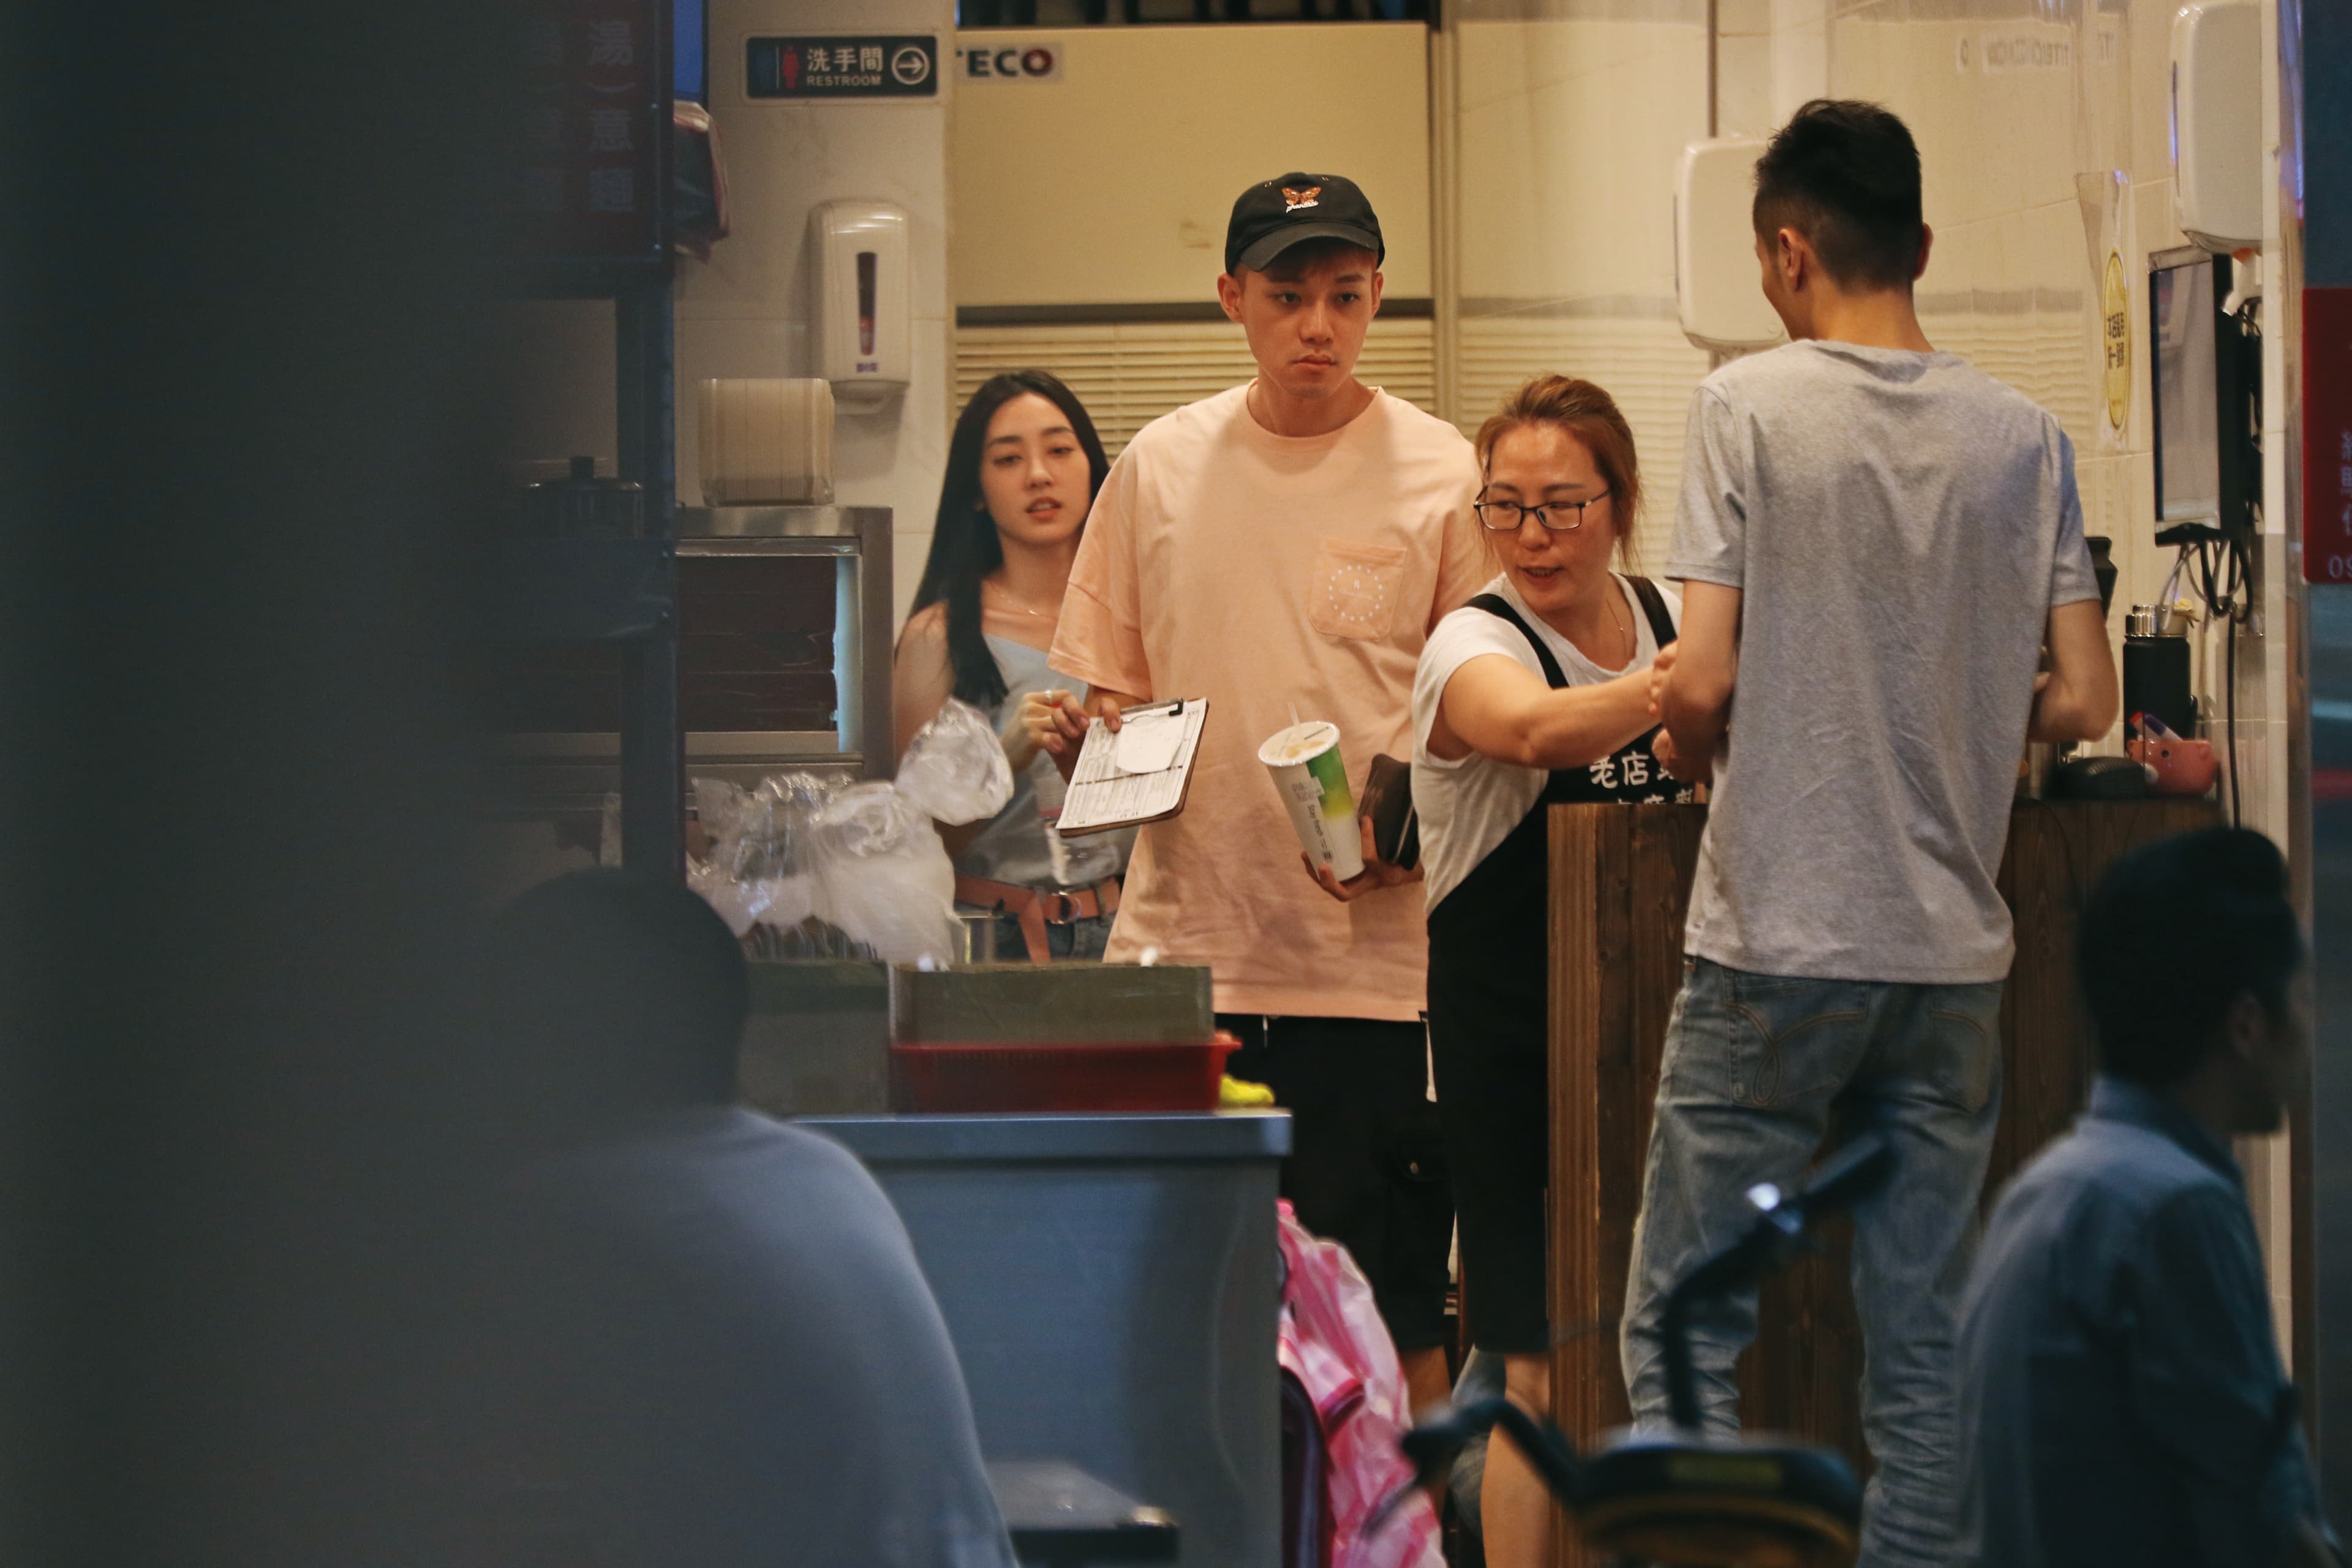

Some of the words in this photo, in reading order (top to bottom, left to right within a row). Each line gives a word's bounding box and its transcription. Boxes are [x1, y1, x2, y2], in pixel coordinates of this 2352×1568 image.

[807, 46, 884, 72] 洗手間
[954, 49, 1054, 77] ECO
[806, 75, 882, 86] RESTROOM
[1589, 750, 1675, 789] 老店
